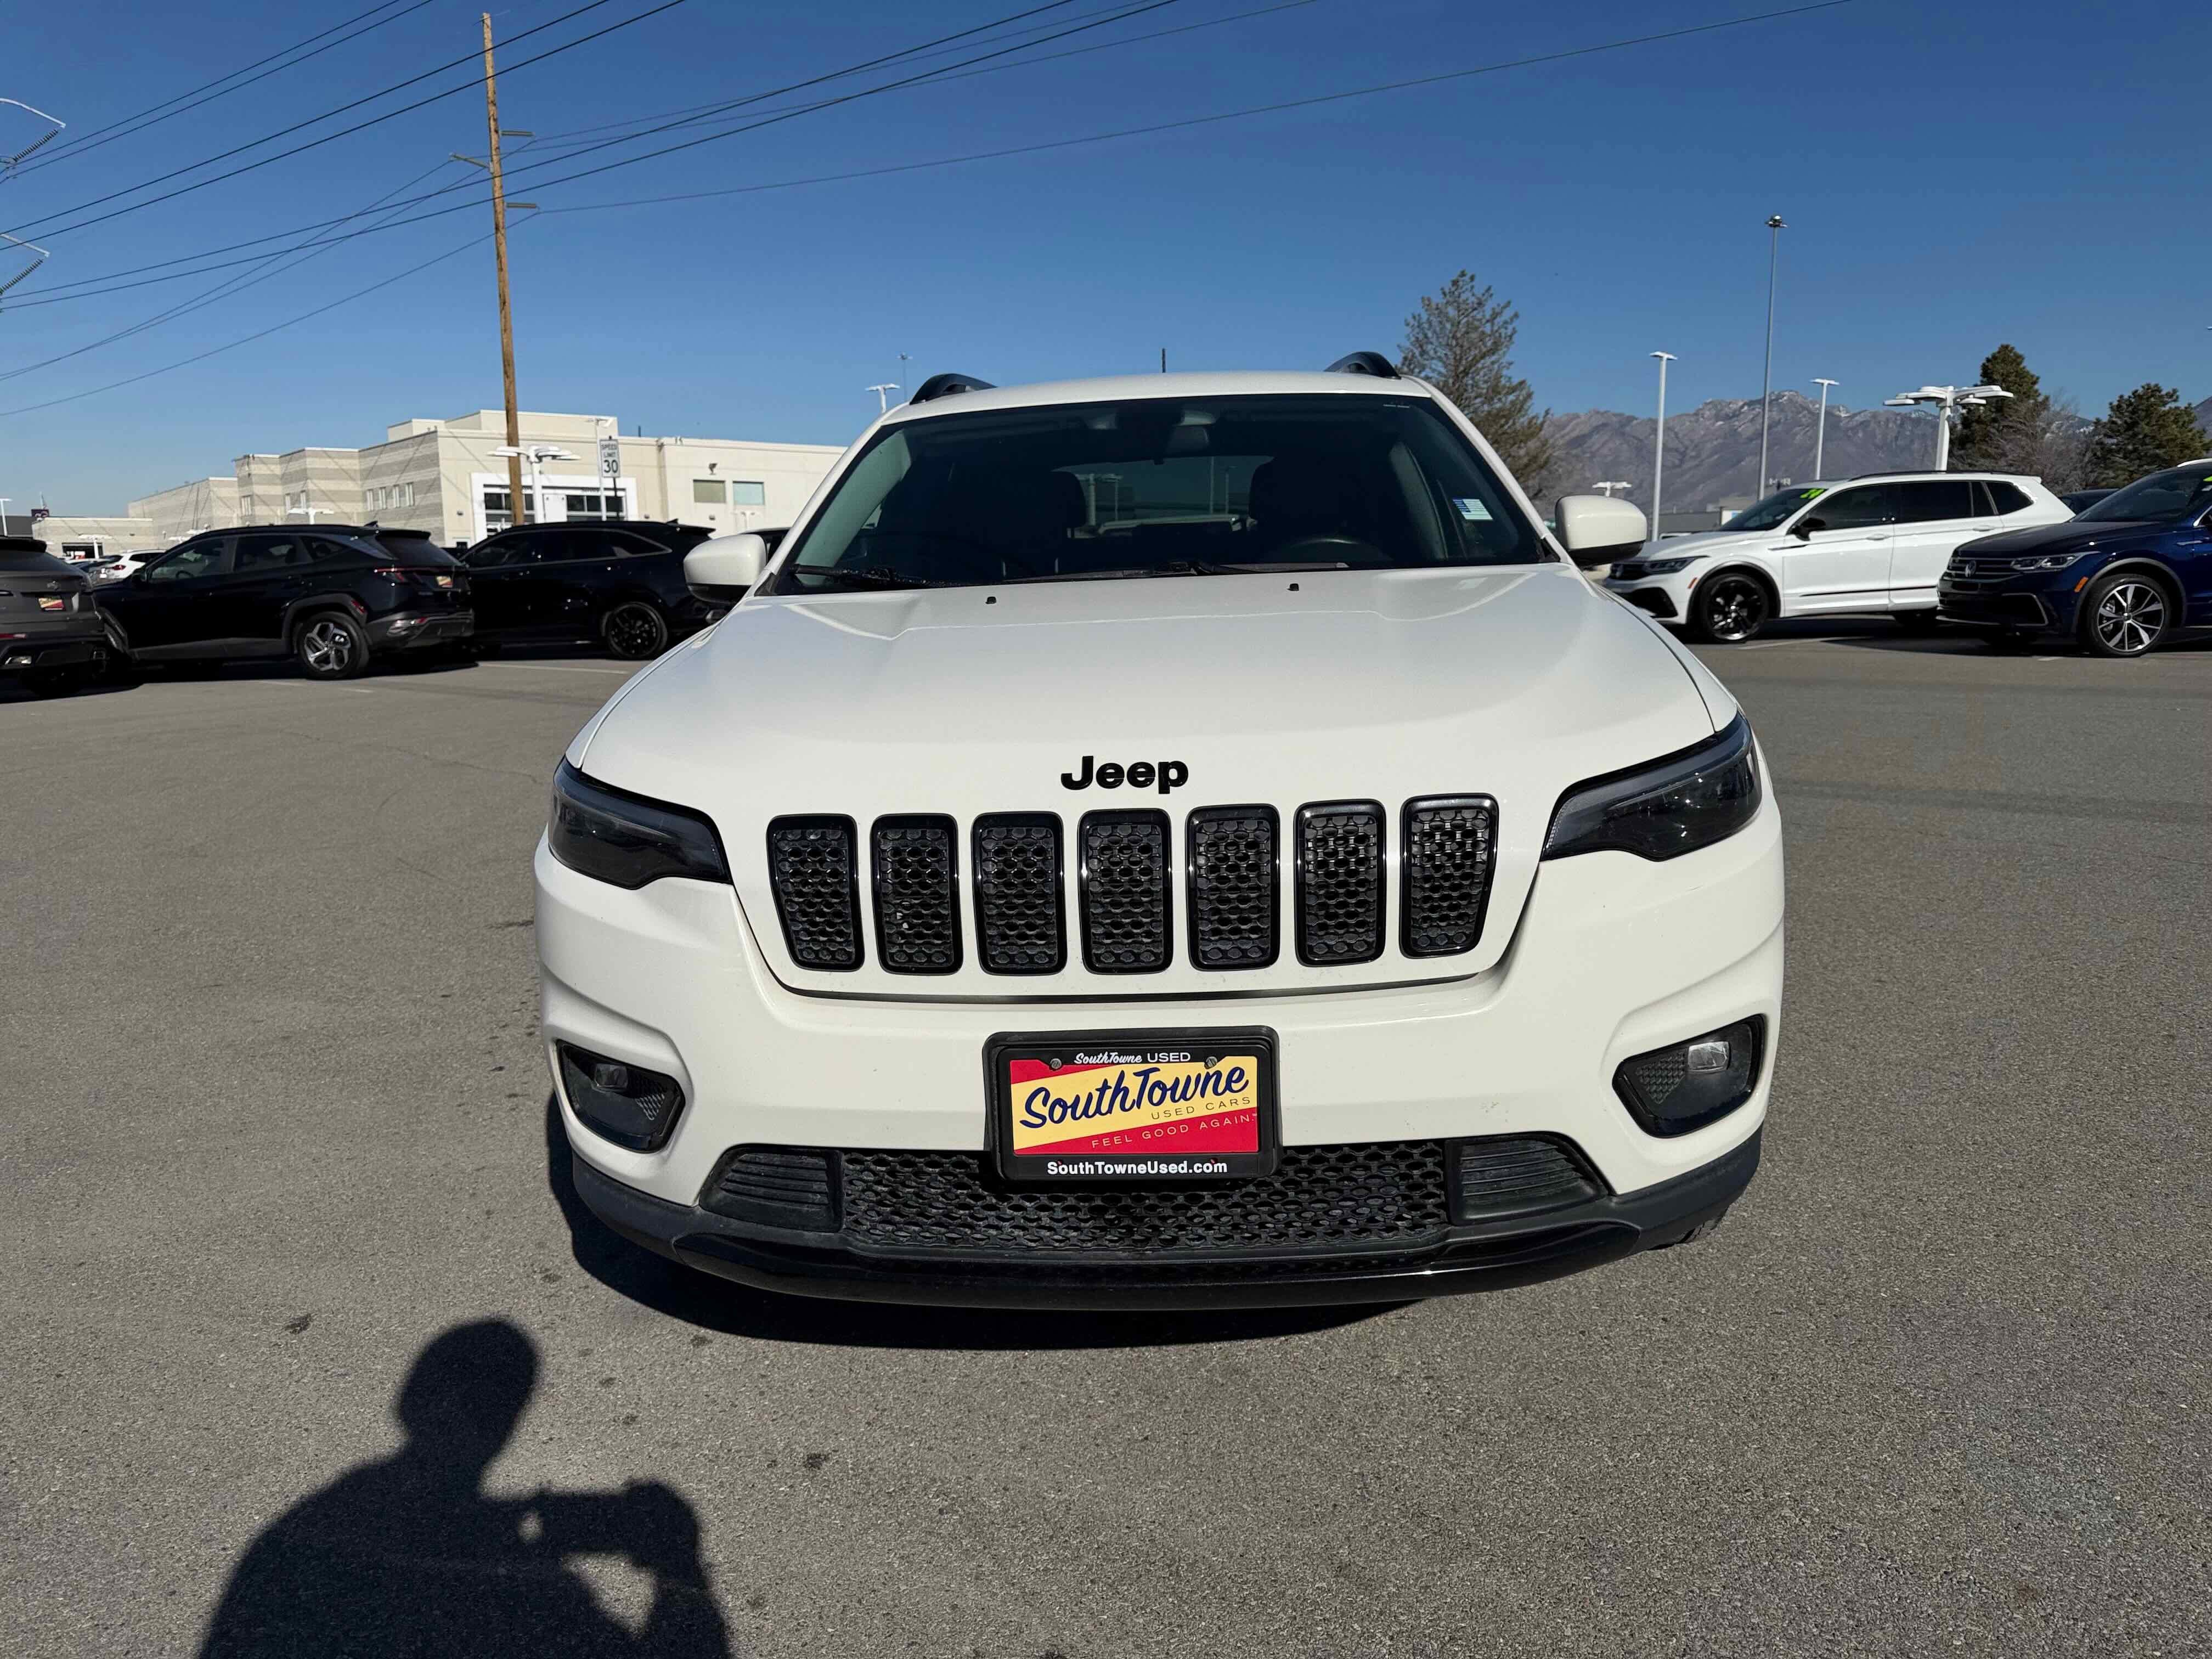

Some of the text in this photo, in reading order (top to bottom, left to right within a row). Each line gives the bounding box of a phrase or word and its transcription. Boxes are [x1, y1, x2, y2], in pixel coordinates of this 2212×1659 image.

[604, 460, 618, 473] 30
[1061, 755, 1188, 794] Jeep
[1074, 1052, 1190, 1064] SouthTowne USED
[1019, 1066, 1249, 1128] SouthTowne
[1151, 1097, 1251, 1120] USED CARS
[1092, 1135, 1132, 1148] FEEL
[1142, 1124, 1189, 1139] GOOD
[1047, 1160, 1227, 1175] SouthTowneUsed.com
